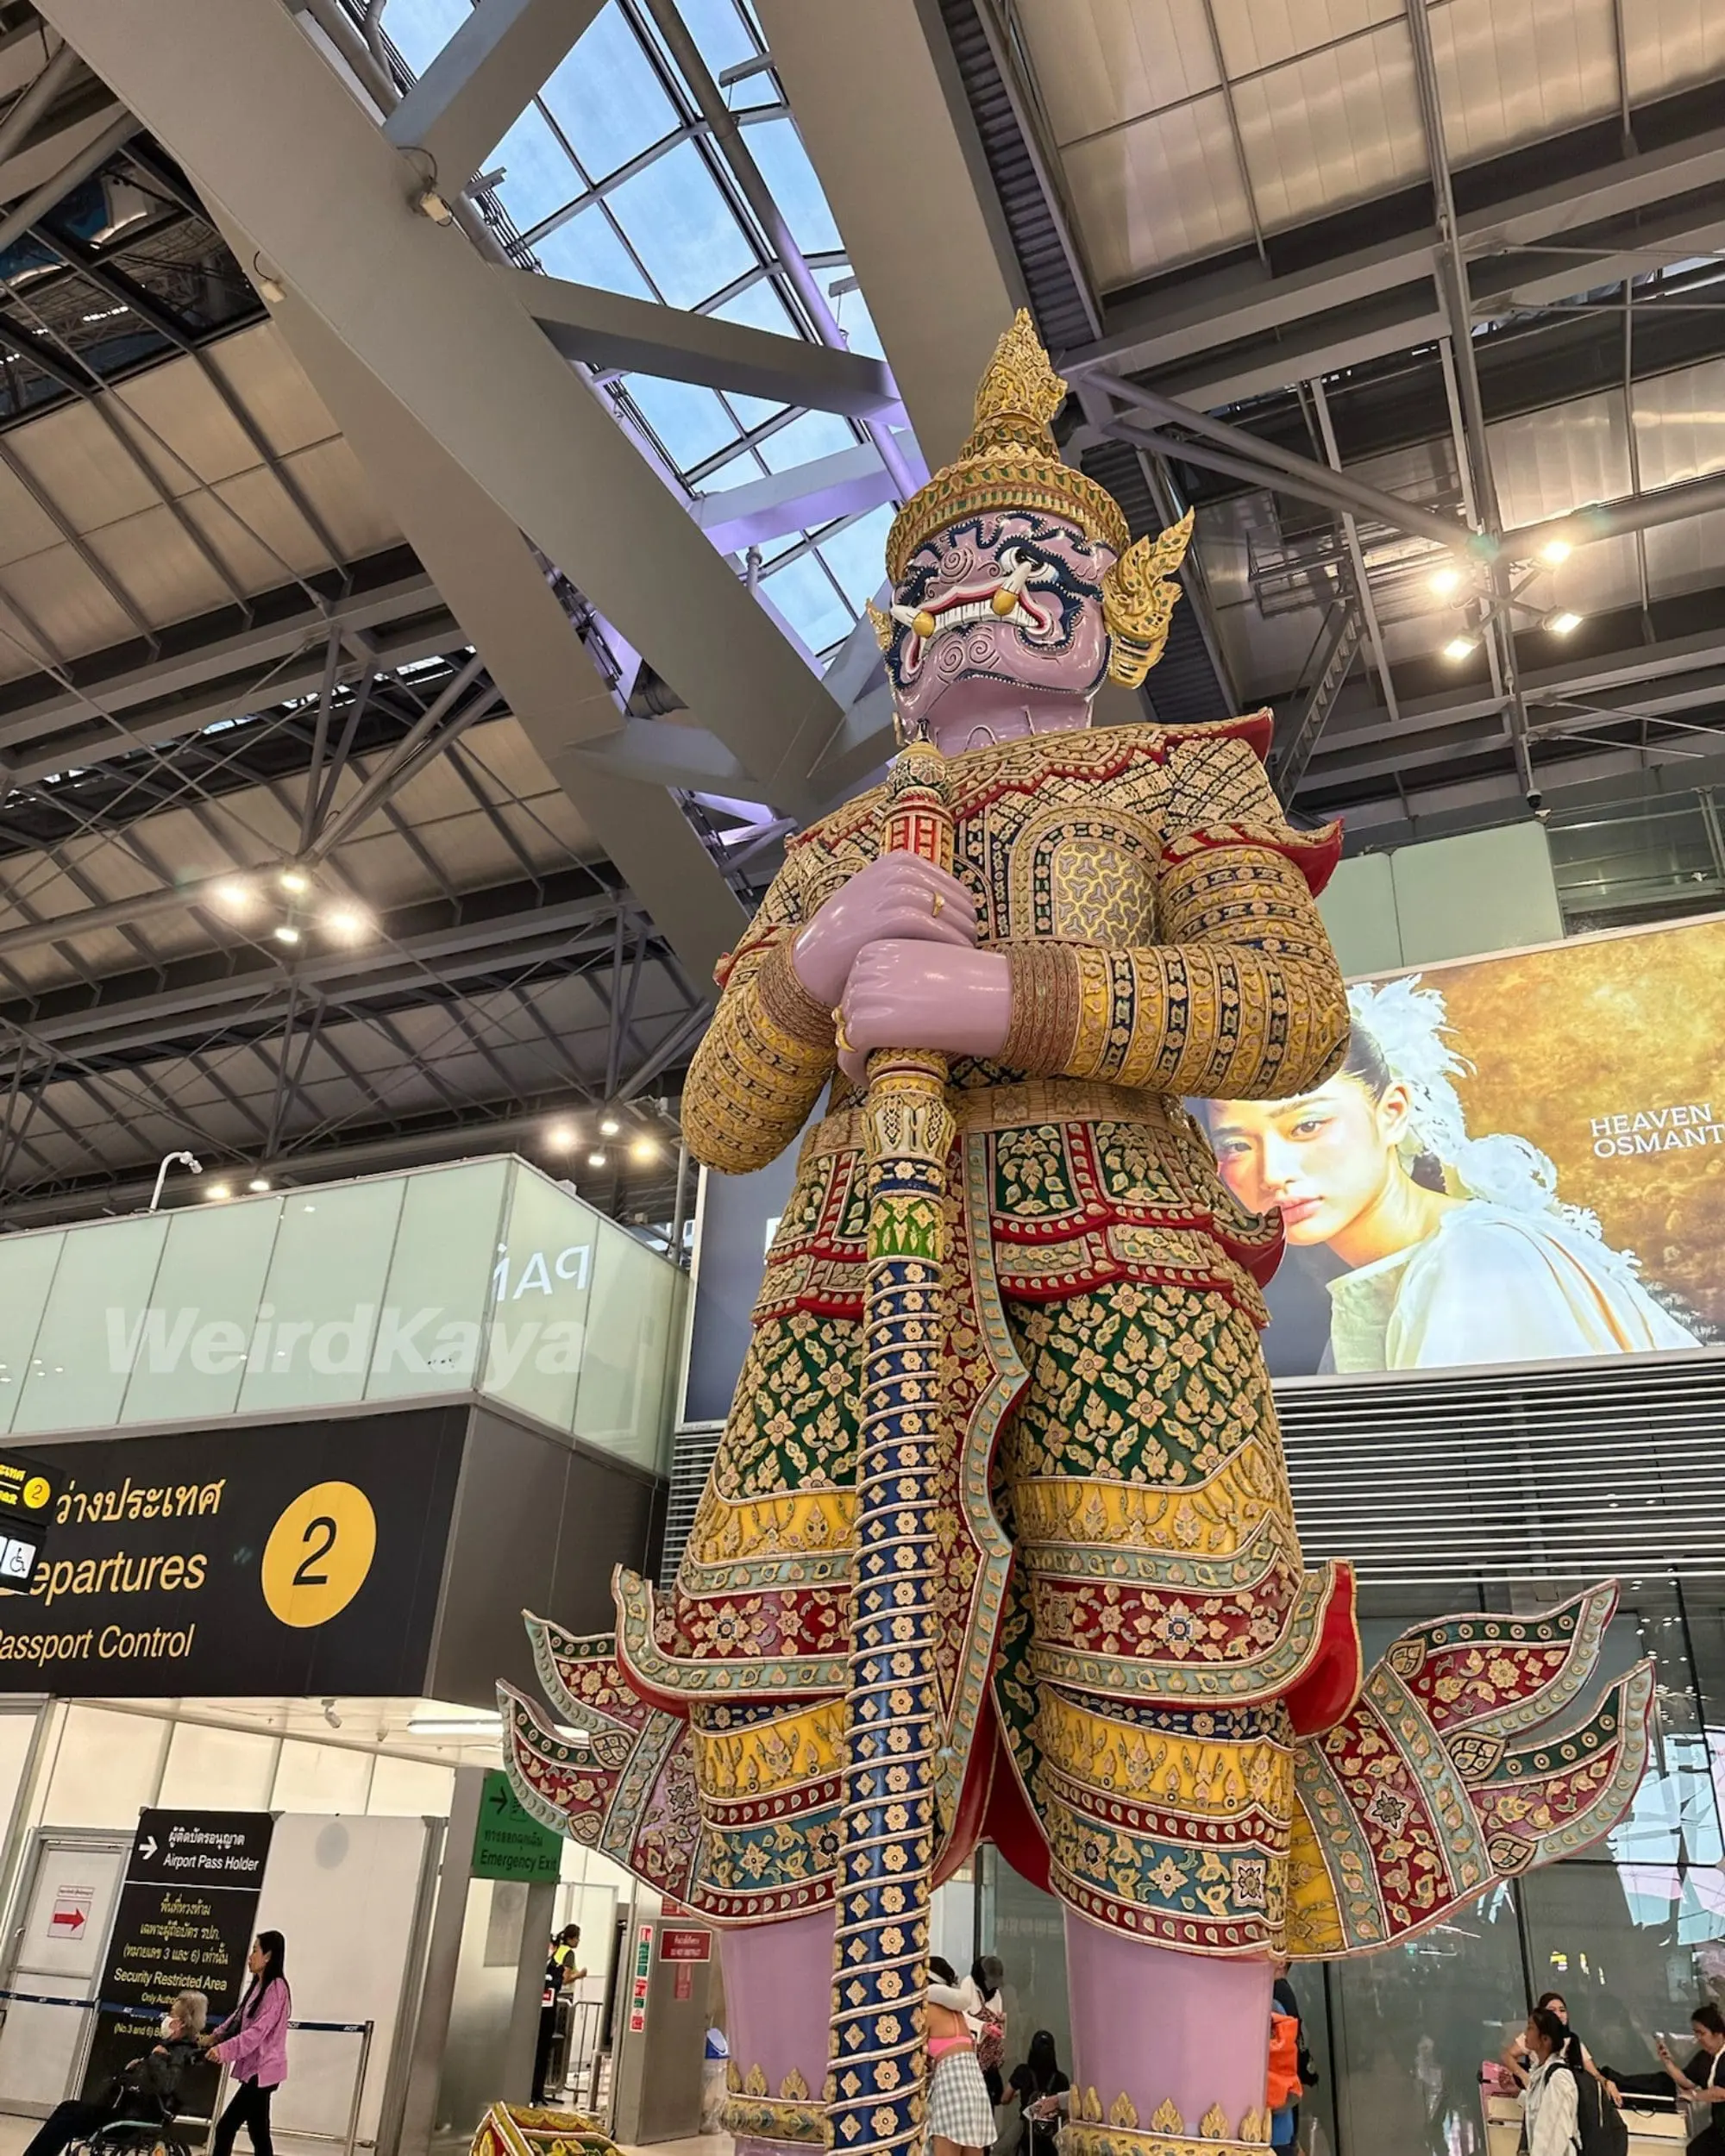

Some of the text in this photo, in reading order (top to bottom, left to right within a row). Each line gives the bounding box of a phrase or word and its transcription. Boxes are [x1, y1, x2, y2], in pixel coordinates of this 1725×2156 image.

[1590, 1103, 1712, 1137] HEAVEN
[1594, 1124, 1725, 1157] OSMANT
[292, 1516, 336, 1586] 2
[0, 1551, 208, 1606] epartures
[98, 1622, 196, 1658] Control
[163, 1852, 259, 1871] Airport Pass Holder
[480, 1849, 557, 1873] Emergency Exit
[163, 1946, 172, 1960] 3
[190, 1949, 200, 1965] 6)
[114, 1967, 227, 1991] Security Restricted Area
[141, 1992, 157, 2005] Only
